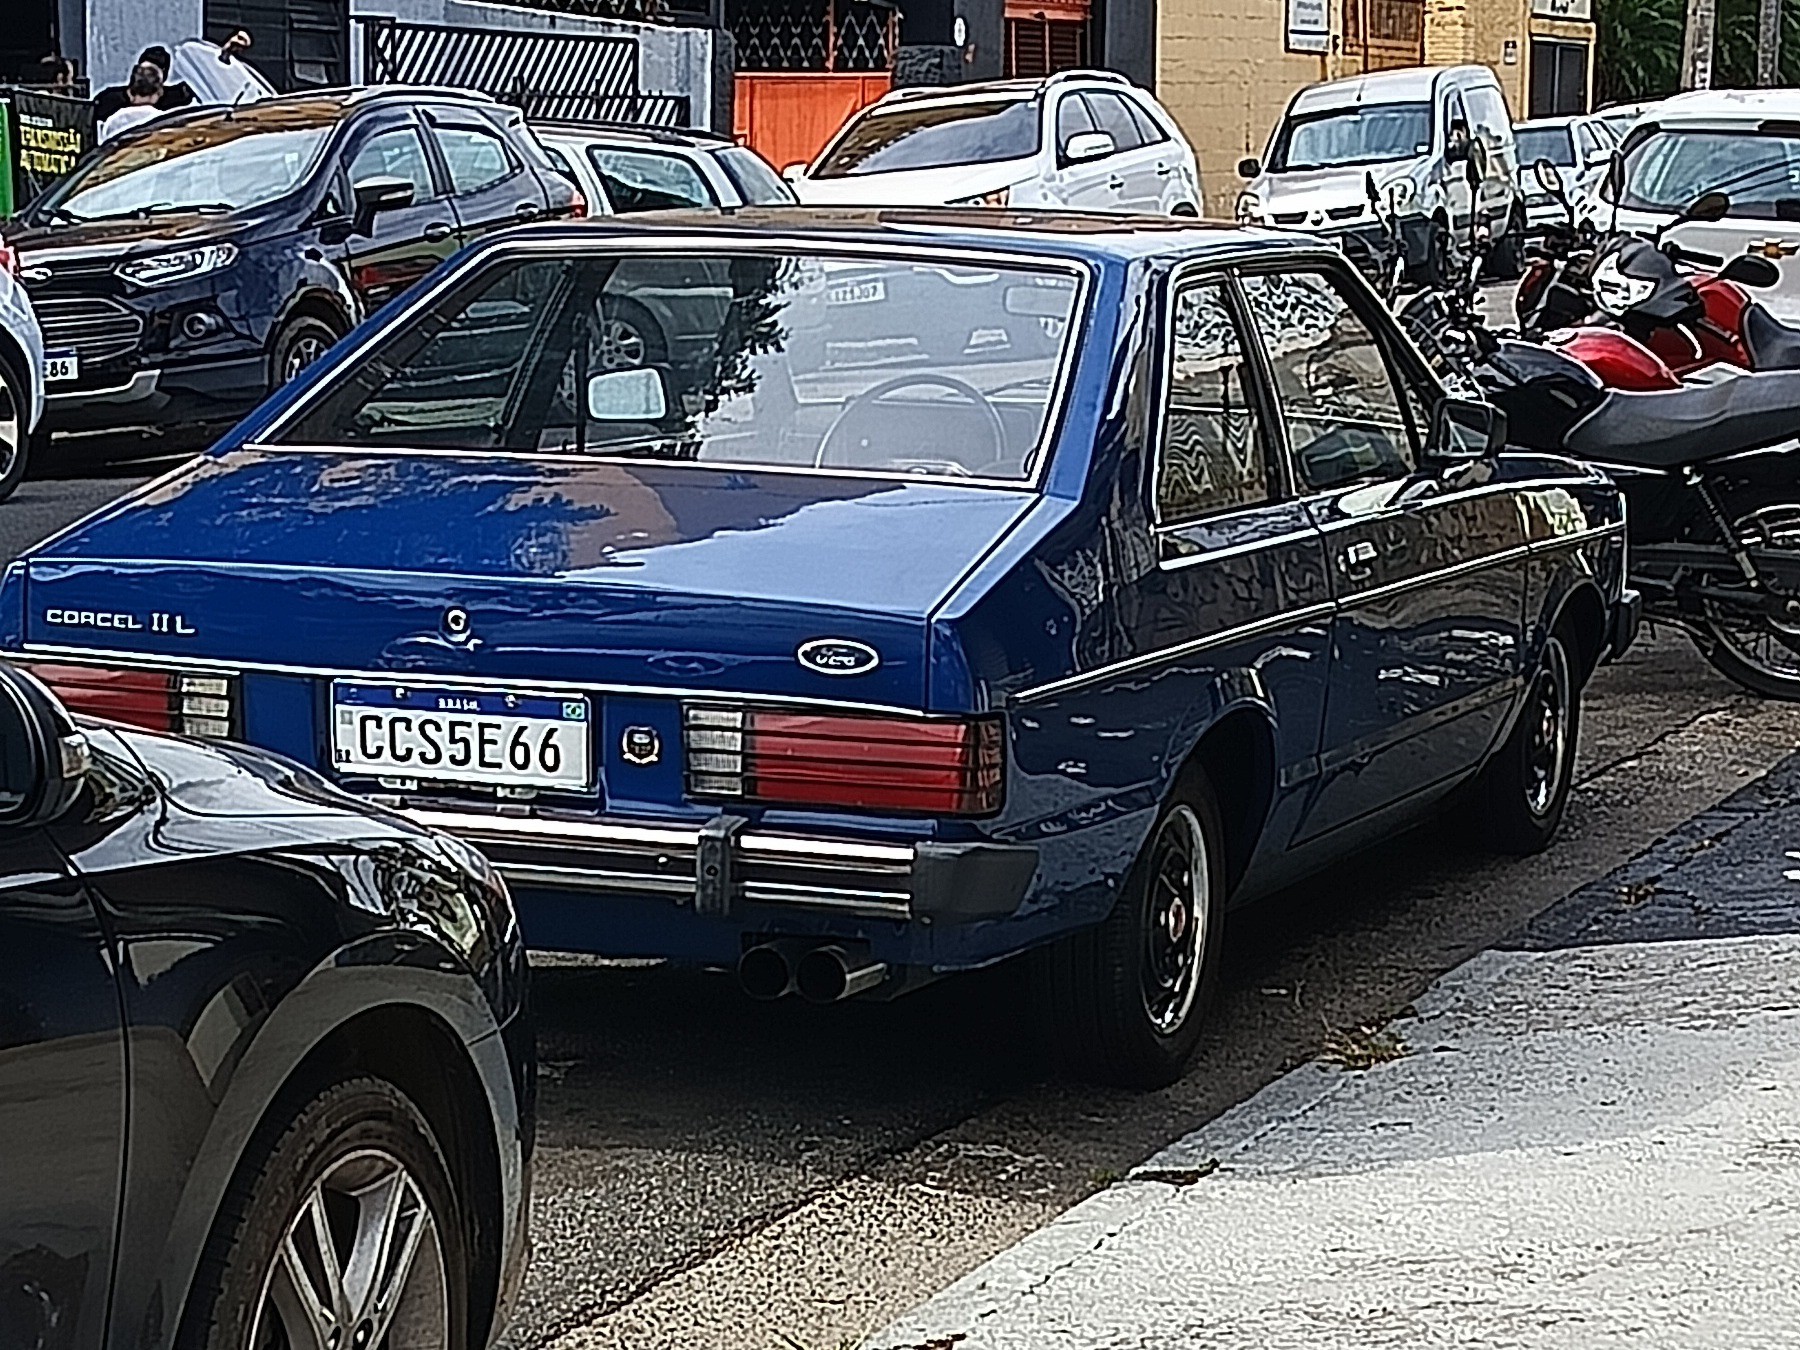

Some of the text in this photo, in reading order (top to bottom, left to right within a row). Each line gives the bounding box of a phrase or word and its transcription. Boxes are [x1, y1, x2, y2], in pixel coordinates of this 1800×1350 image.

[46, 609, 143, 629] CORCEL
[175, 615, 196, 634] L
[359, 714, 561, 773] CCS5E66
